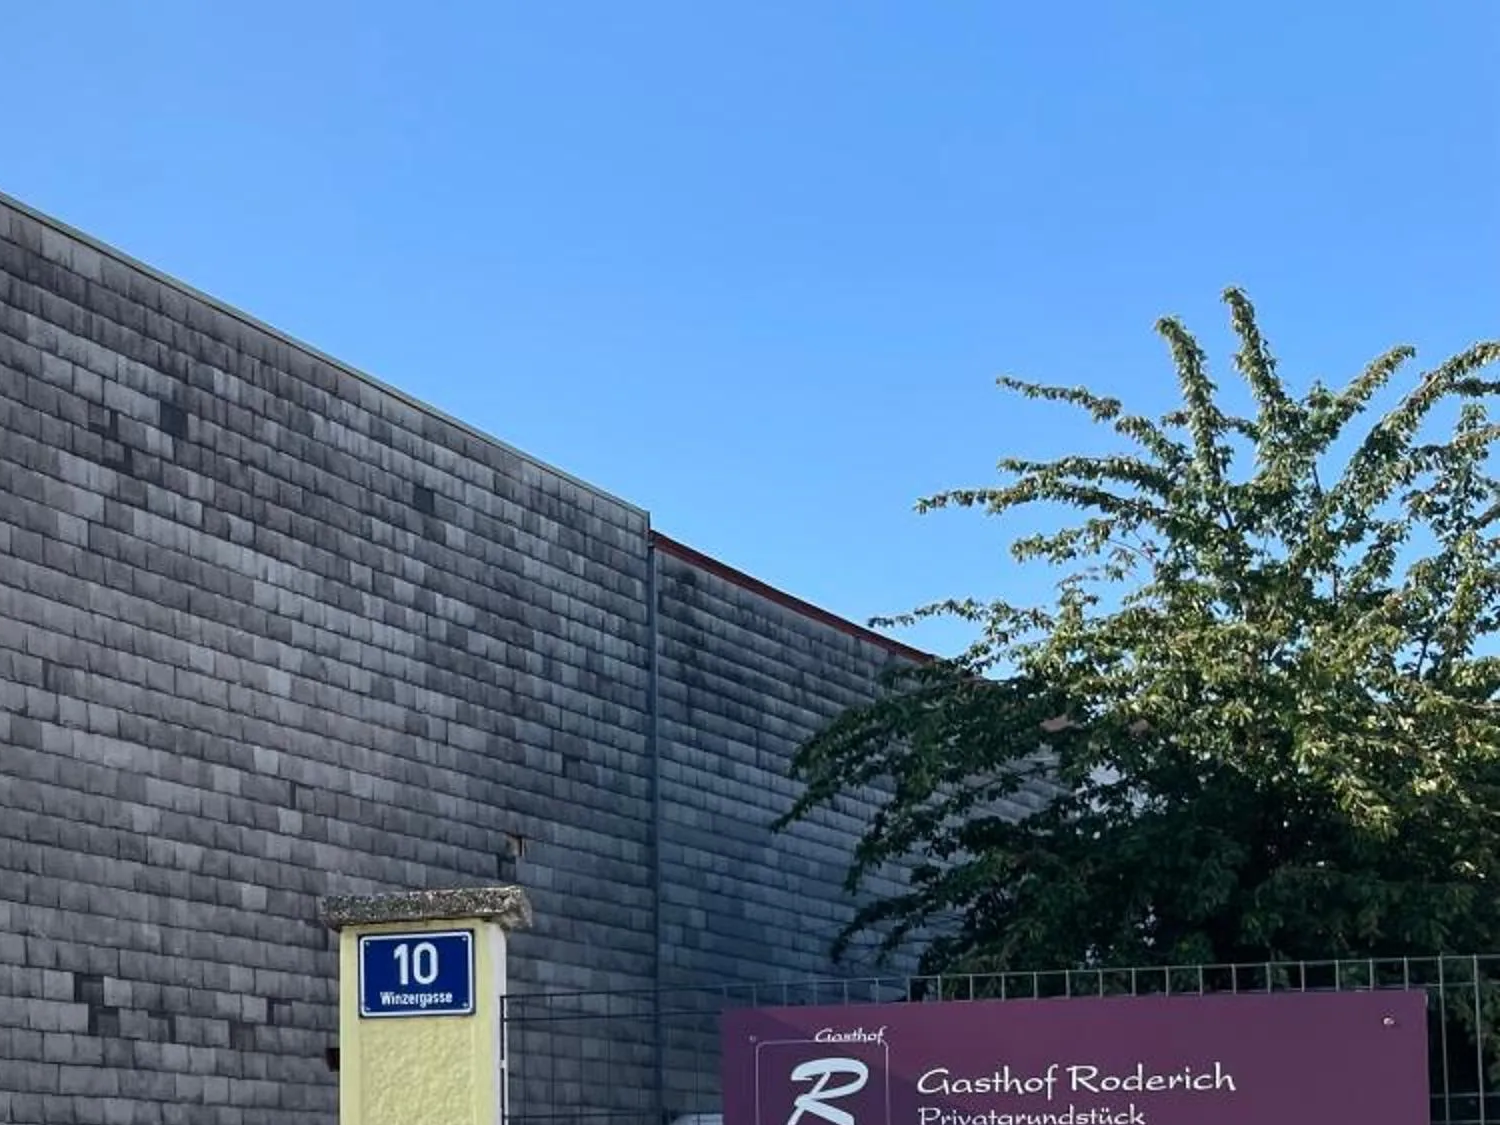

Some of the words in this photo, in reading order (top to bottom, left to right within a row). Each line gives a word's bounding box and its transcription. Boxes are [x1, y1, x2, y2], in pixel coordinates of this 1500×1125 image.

[393, 941, 438, 985] 10
[380, 991, 453, 1008] Winzergasse
[815, 1025, 887, 1045] Gasthof
[916, 1063, 1059, 1100] Gasthof
[1065, 1061, 1237, 1093] Roderich
